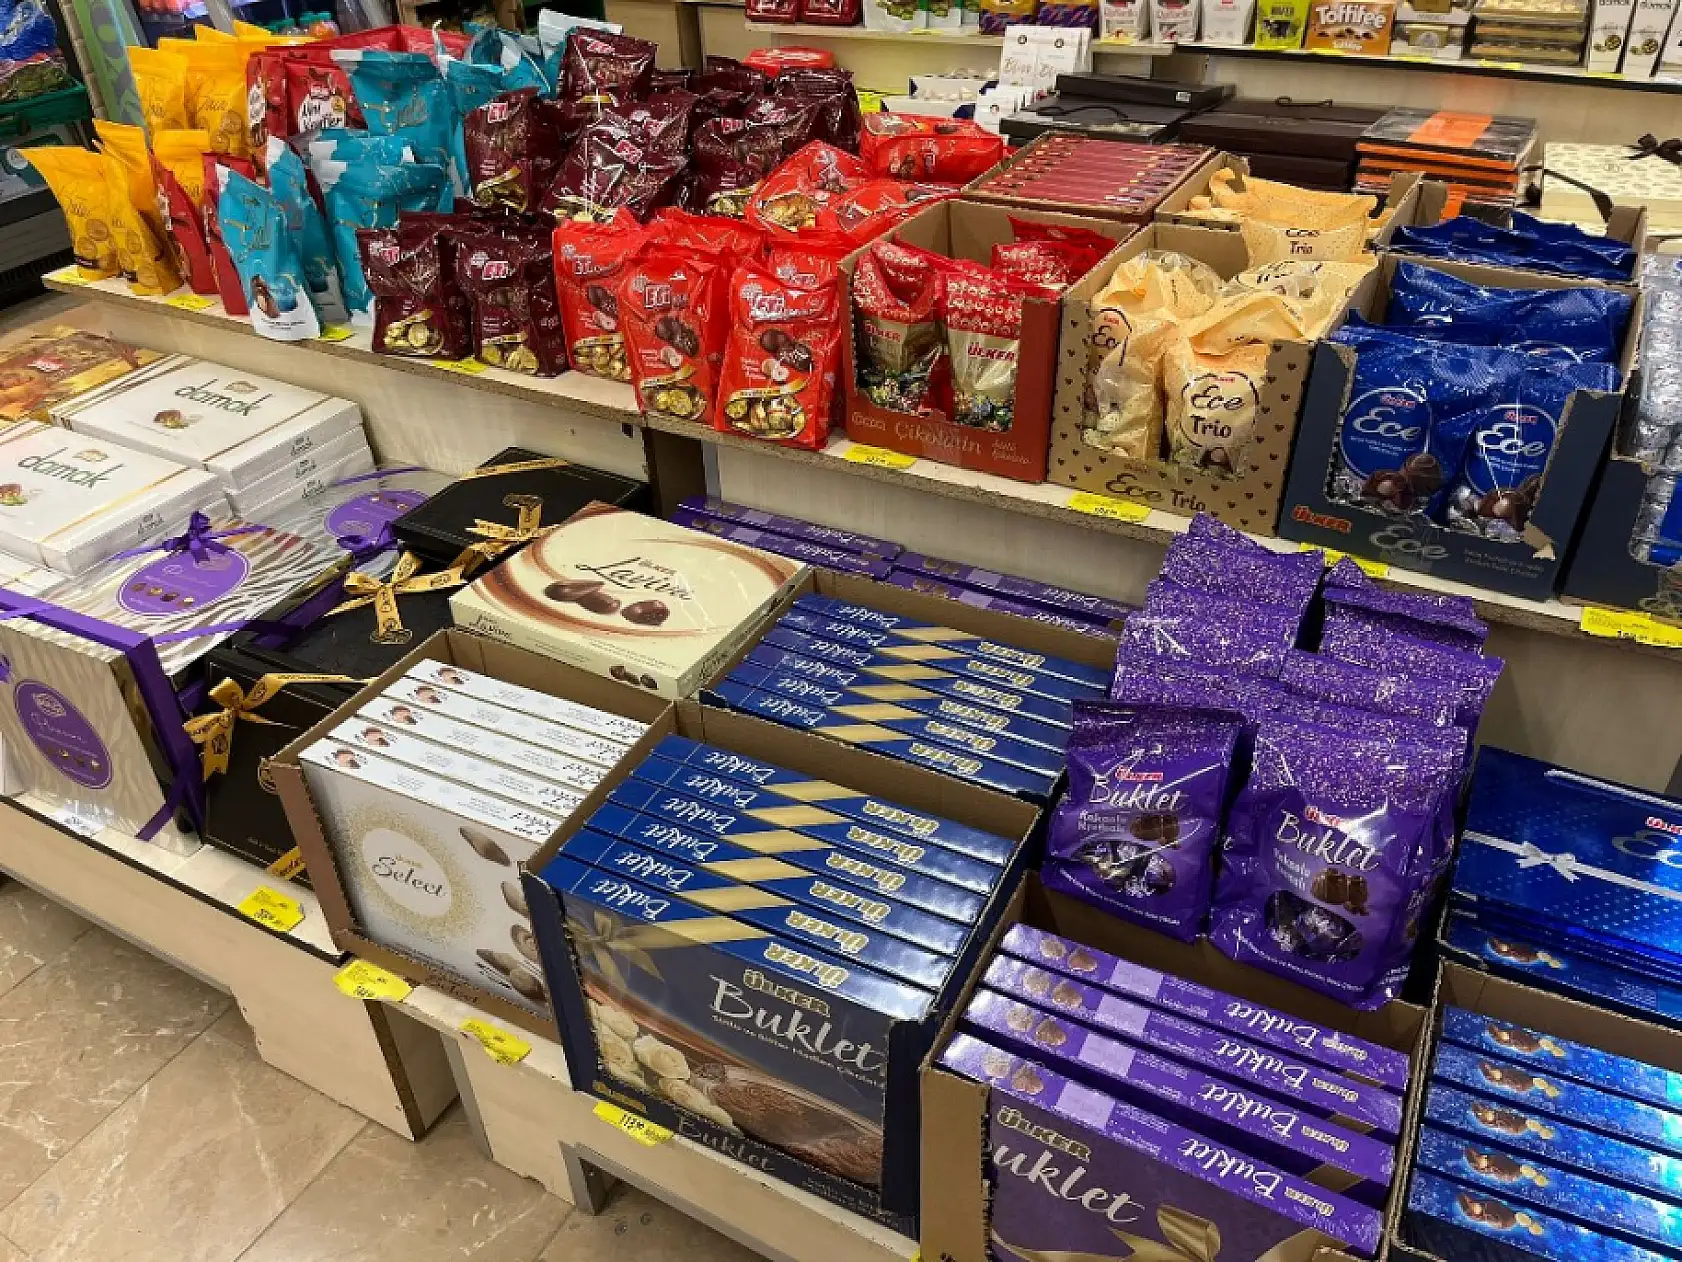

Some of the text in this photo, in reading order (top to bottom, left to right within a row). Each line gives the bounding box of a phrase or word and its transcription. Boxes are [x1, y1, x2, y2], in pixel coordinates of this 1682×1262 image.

[1315, 4, 1386, 29] Toffifee
[1290, 240, 1313, 255] Trio
[1191, 384, 1245, 410] Ece
[1189, 414, 1232, 438] Trio
[1352, 407, 1422, 441] Ece
[1476, 422, 1546, 457] Ece
[1106, 473, 1206, 511] Ece Trio
[1369, 524, 1449, 559] Ece
[705, 749, 775, 785] Buklet
[687, 775, 758, 809] Buklet
[1088, 774, 1186, 812] Buklet
[665, 798, 736, 834] Buklet
[645, 823, 718, 861] Buklet
[1276, 808, 1384, 872] Buklet
[1611, 829, 1682, 869] Ec
[372, 856, 447, 898] Select
[616, 851, 694, 891] Buklet
[589, 880, 670, 920] Buklet
[709, 973, 887, 1072] Buklet
[1227, 1001, 1317, 1047] Buklet
[1214, 1039, 1306, 1087] Buklet
[1199, 1083, 1299, 1137] Buklet
[985, 1139, 1146, 1224] uklet
[1177, 1136, 1284, 1199] Buklet
